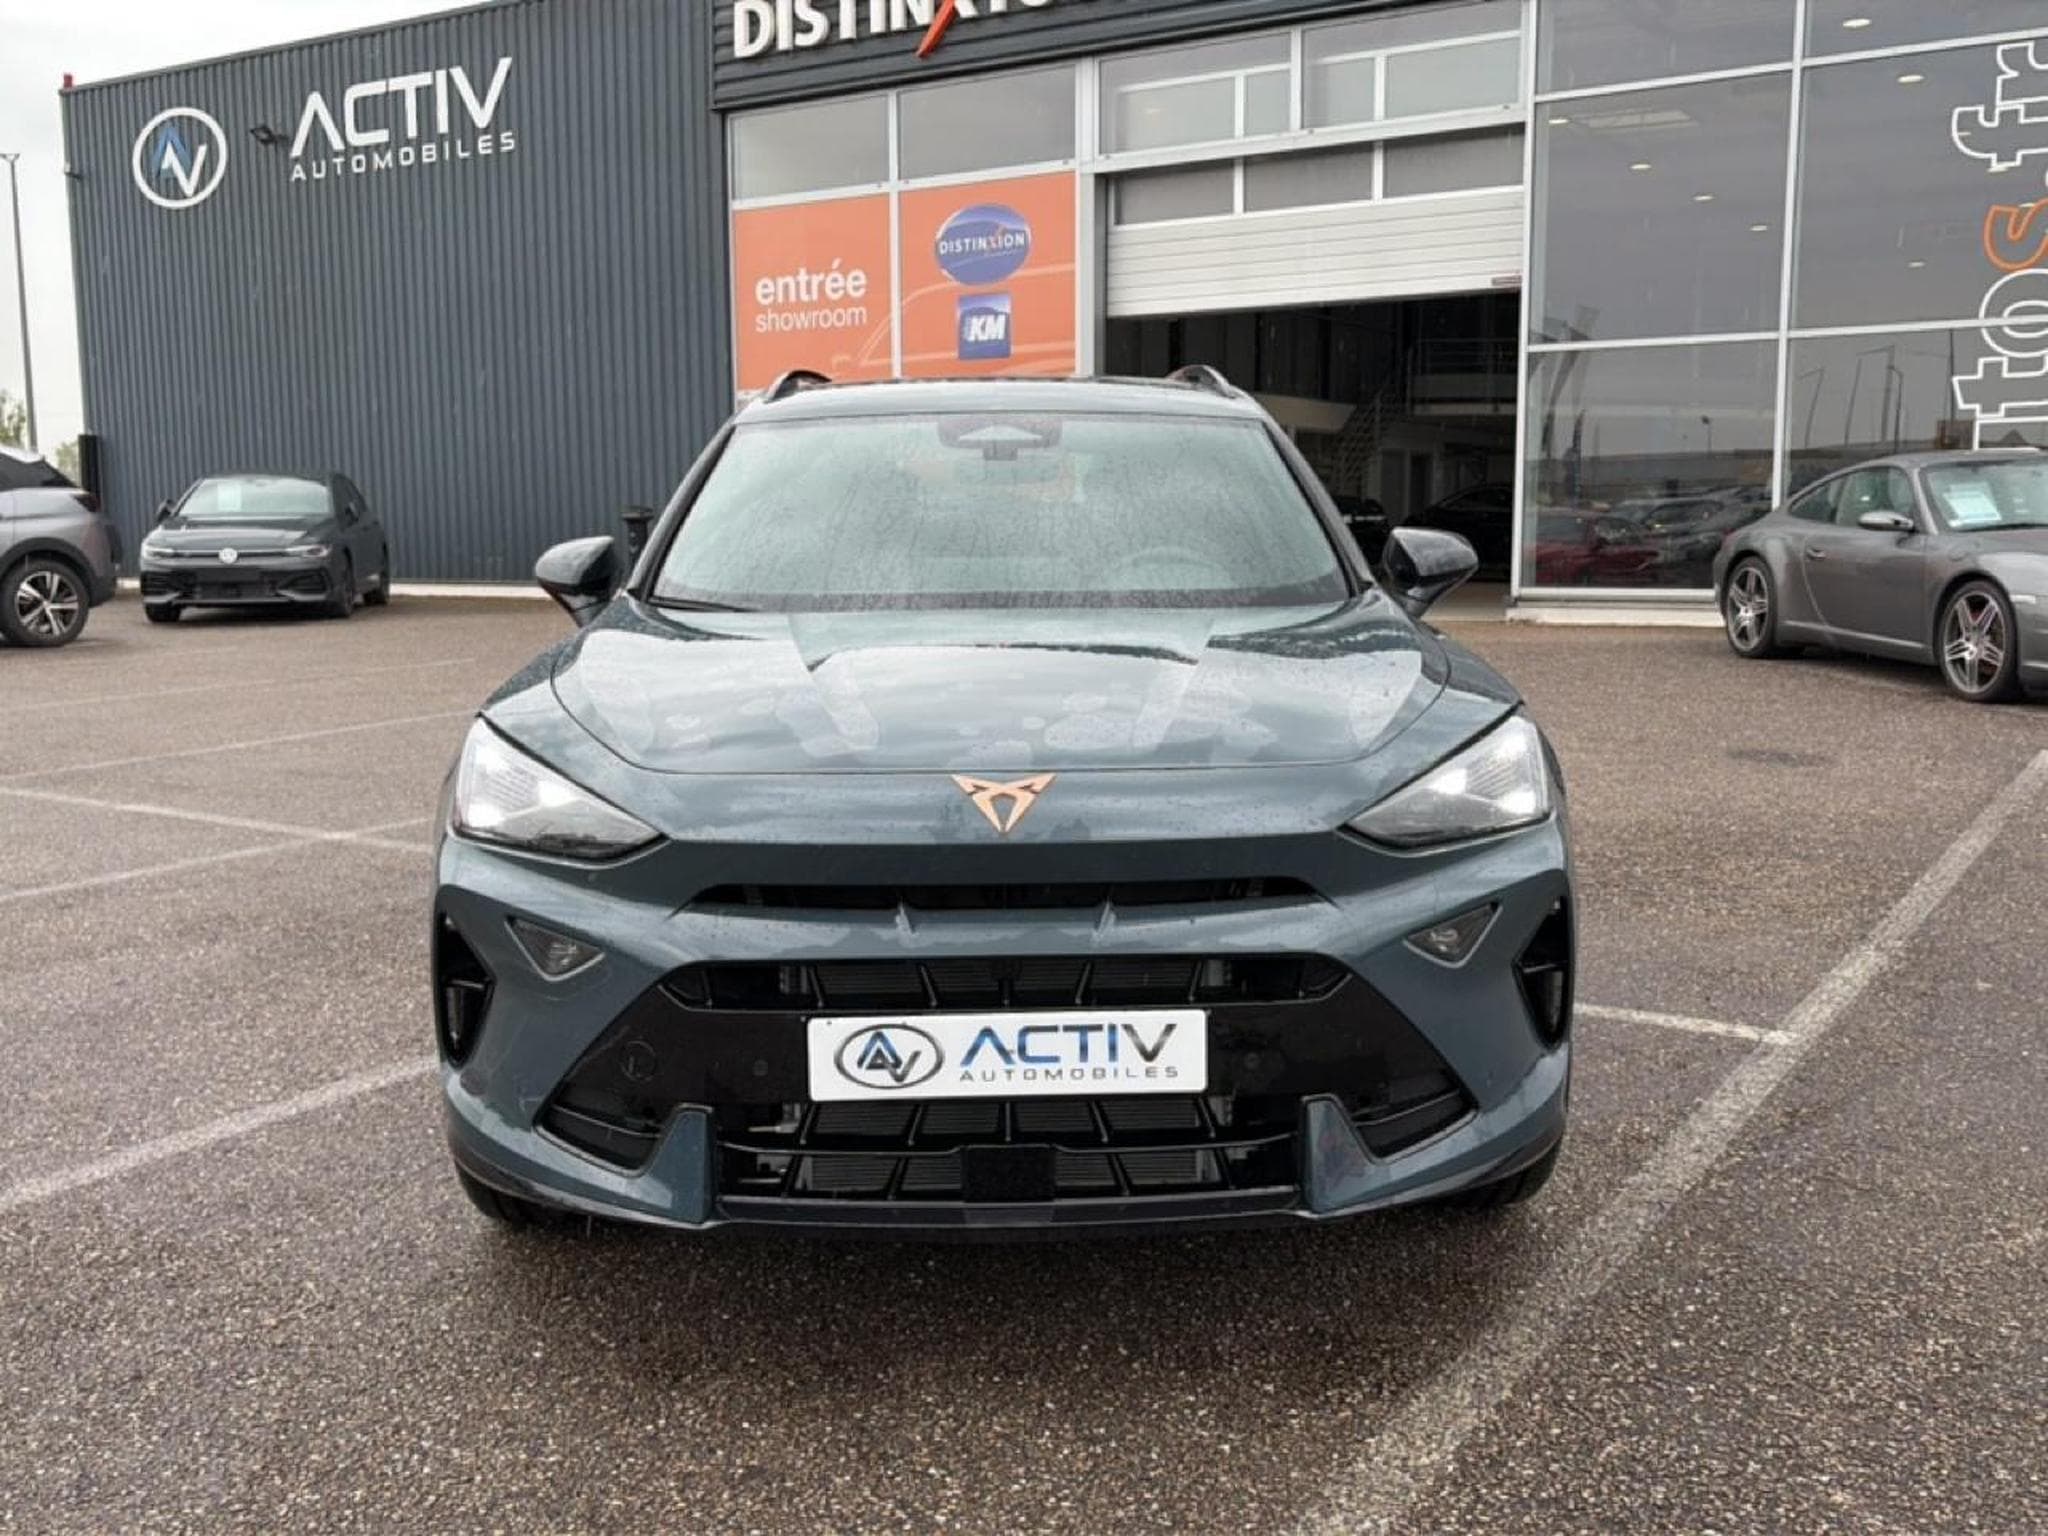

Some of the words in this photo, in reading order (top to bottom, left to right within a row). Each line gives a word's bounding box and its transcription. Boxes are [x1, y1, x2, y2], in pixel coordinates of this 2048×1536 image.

[290, 57, 512, 159] ACTIV
[291, 131, 516, 182] AUTOMOBILES
[939, 230, 1026, 256] DISTINXION
[755, 257, 867, 305] entrée
[755, 306, 868, 333] showroom
[967, 314, 1006, 342] KM
[959, 1023, 1178, 1067] ACTIV
[959, 1065, 1179, 1082] AUTOMOBILES
